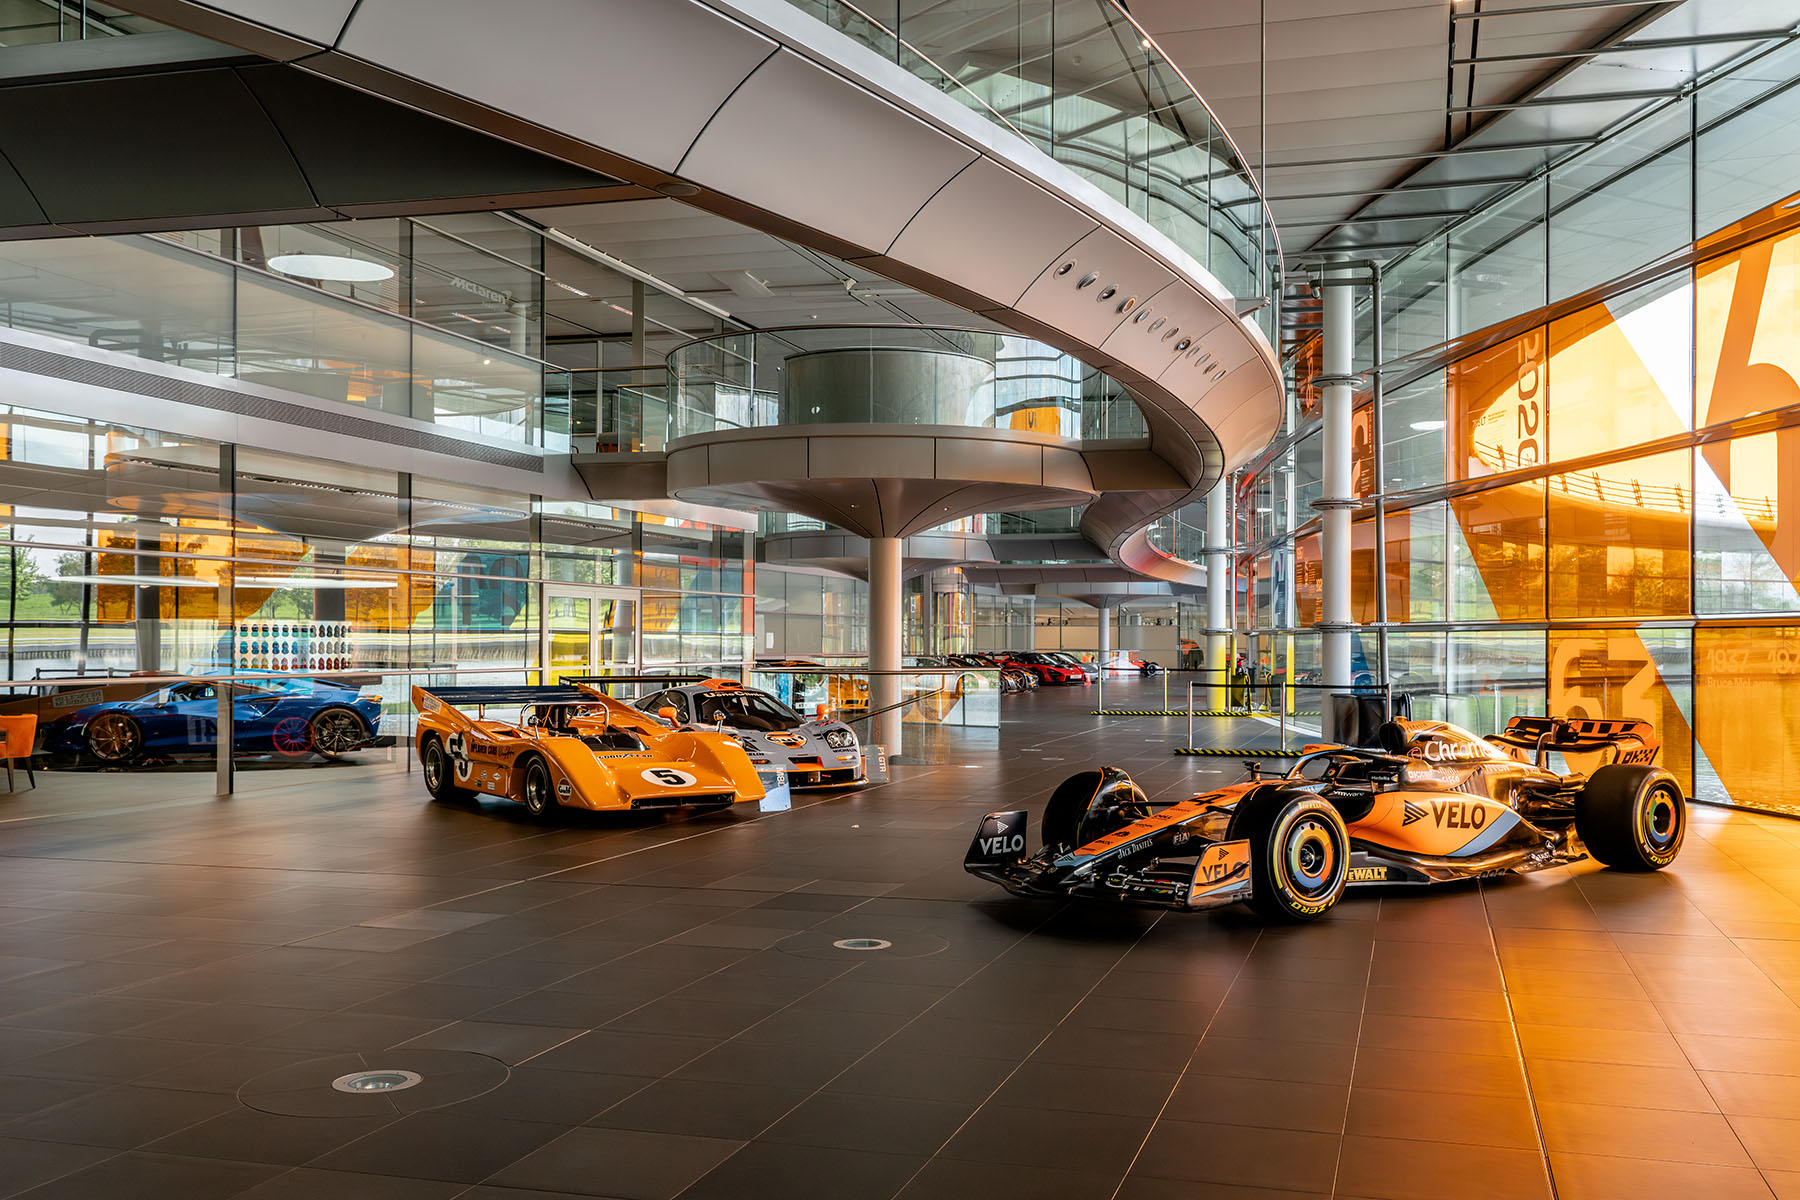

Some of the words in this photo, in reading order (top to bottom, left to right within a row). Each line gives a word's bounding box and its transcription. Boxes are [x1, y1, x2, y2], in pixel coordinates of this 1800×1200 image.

[450, 277, 506, 304] McLaren
[878, 756, 887, 772] GTR
[650, 769, 686, 785] 5
[558, 785, 572, 794] Gulf
[1430, 801, 1486, 830] VELO
[979, 834, 1024, 855] VELO
[1173, 831, 1190, 845] FIA
[1202, 861, 1246, 882] VELO
[1290, 900, 1327, 914] ZERO
